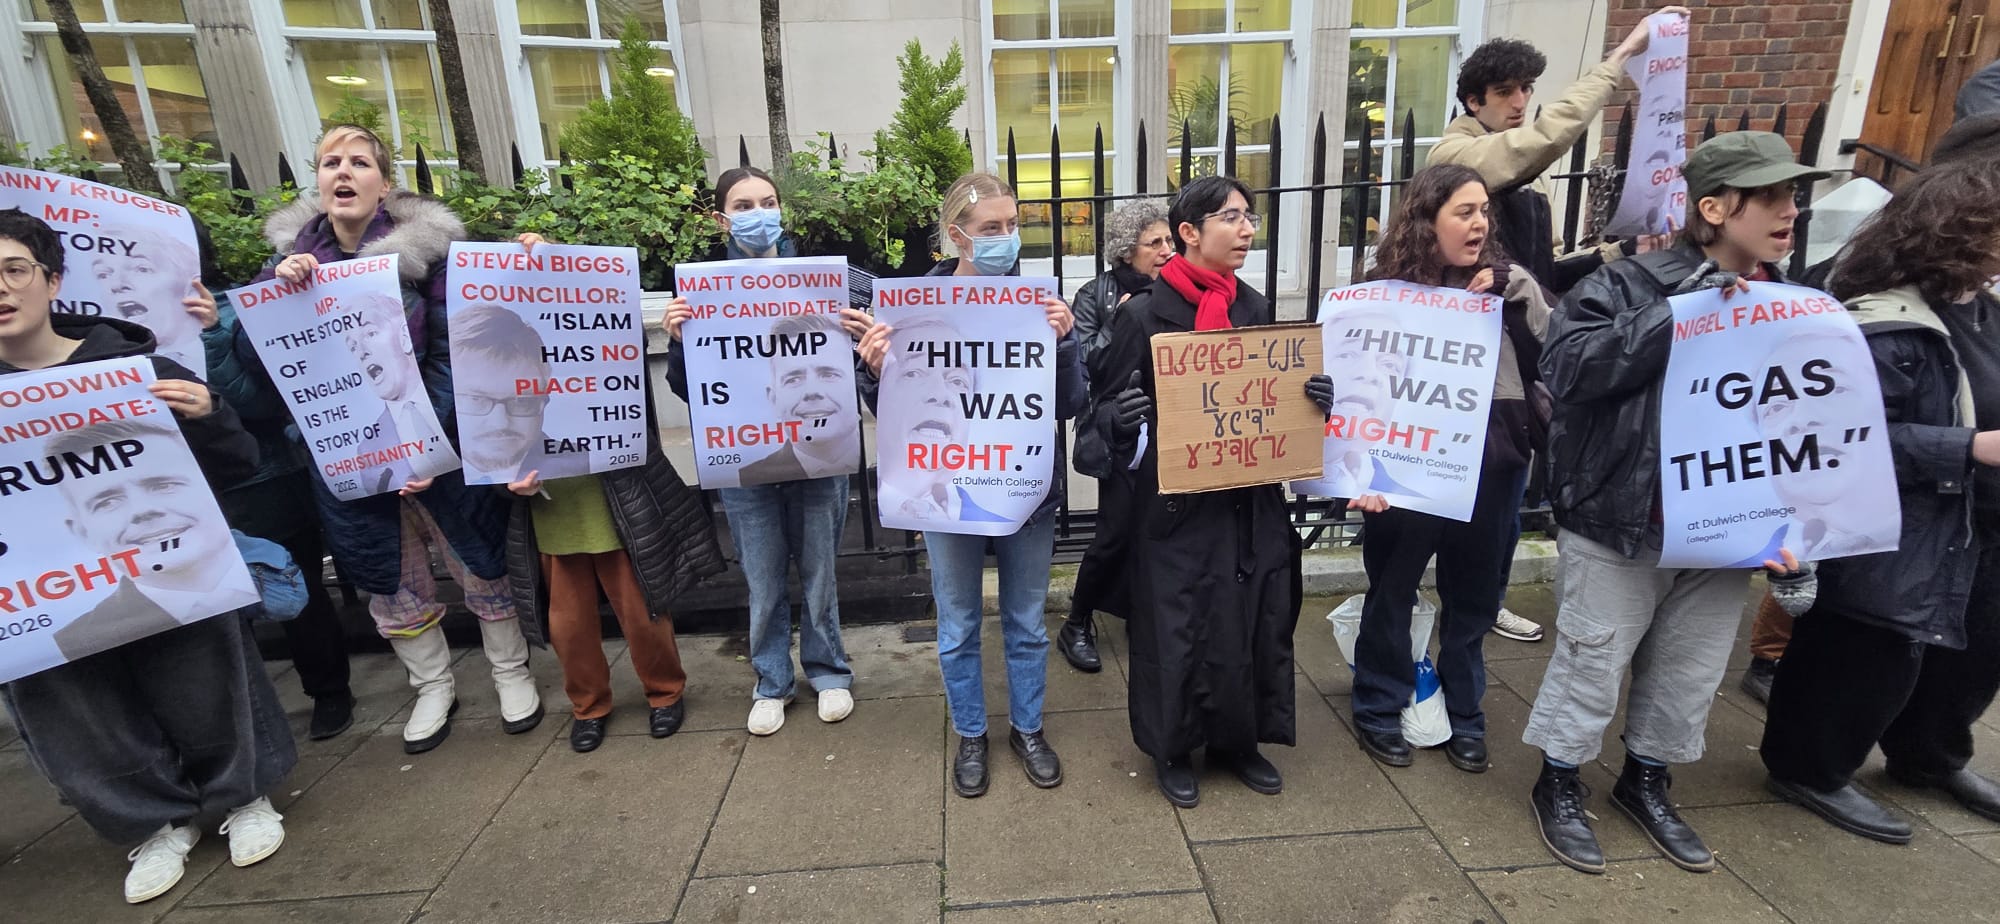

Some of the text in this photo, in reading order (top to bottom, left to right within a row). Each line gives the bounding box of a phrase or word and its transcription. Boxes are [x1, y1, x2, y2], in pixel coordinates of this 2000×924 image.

[1649, 55, 1687, 75] ENOC
[70, 182, 181, 217] KRUGER
[44, 204, 100, 228] MP:
[316, 257, 390, 285] KRUGER
[455, 251, 632, 277] STEVEN BIGGS,
[461, 283, 627, 305] COUNCILLOR:
[678, 275, 735, 292] MATT
[740, 272, 843, 290] GOODWIN
[314, 296, 340, 317] MP:
[688, 304, 717, 320] MP
[722, 299, 843, 319] CANDIDATE:
[879, 287, 946, 308] NIGEL
[1328, 286, 1497, 314] NIGEL FARAGE:
[265, 311, 364, 350] “THE STORY
[538, 312, 632, 332] “ISLAM
[1674, 297, 1844, 343] NIGEL FARAGE:
[541, 344, 639, 363] HAS NO
[696, 331, 828, 361] “TRUMP
[907, 341, 1045, 369] “HITLER
[1344, 328, 1487, 368] “HITLER
[279, 360, 308, 379] OF
[292, 372, 362, 405] ENGLAND
[515, 374, 640, 397] PLACE ON
[700, 381, 730, 407] IS
[1389, 375, 1479, 412] WAS
[1689, 358, 1836, 410] “GAS
[304, 405, 350, 430] IS THE
[588, 404, 642, 423] THIS
[959, 392, 1043, 421] WAS
[316, 422, 381, 454] STORY OF
[544, 432, 642, 455] EARTH.”
[705, 418, 828, 450] RIGHT.”
[1324, 414, 1472, 455] RIGHT.”
[325, 435, 440, 478] CHRISTIANITY.”
[609, 453, 640, 466] 2015
[707, 453, 742, 466] 2026
[907, 443, 1043, 472] RIGHT.”
[1368, 447, 1469, 473] at Dulwich College
[1670, 426, 1871, 492] THEM.”
[334, 479, 358, 494] 2025
[952, 475, 1044, 490] at Dulwich College
[1426, 468, 1467, 482] (allegedly)
[1007, 488, 1043, 498] (allegedly)
[1687, 504, 1797, 531] at Dulwich College
[1686, 530, 1729, 545] (allegedly)
